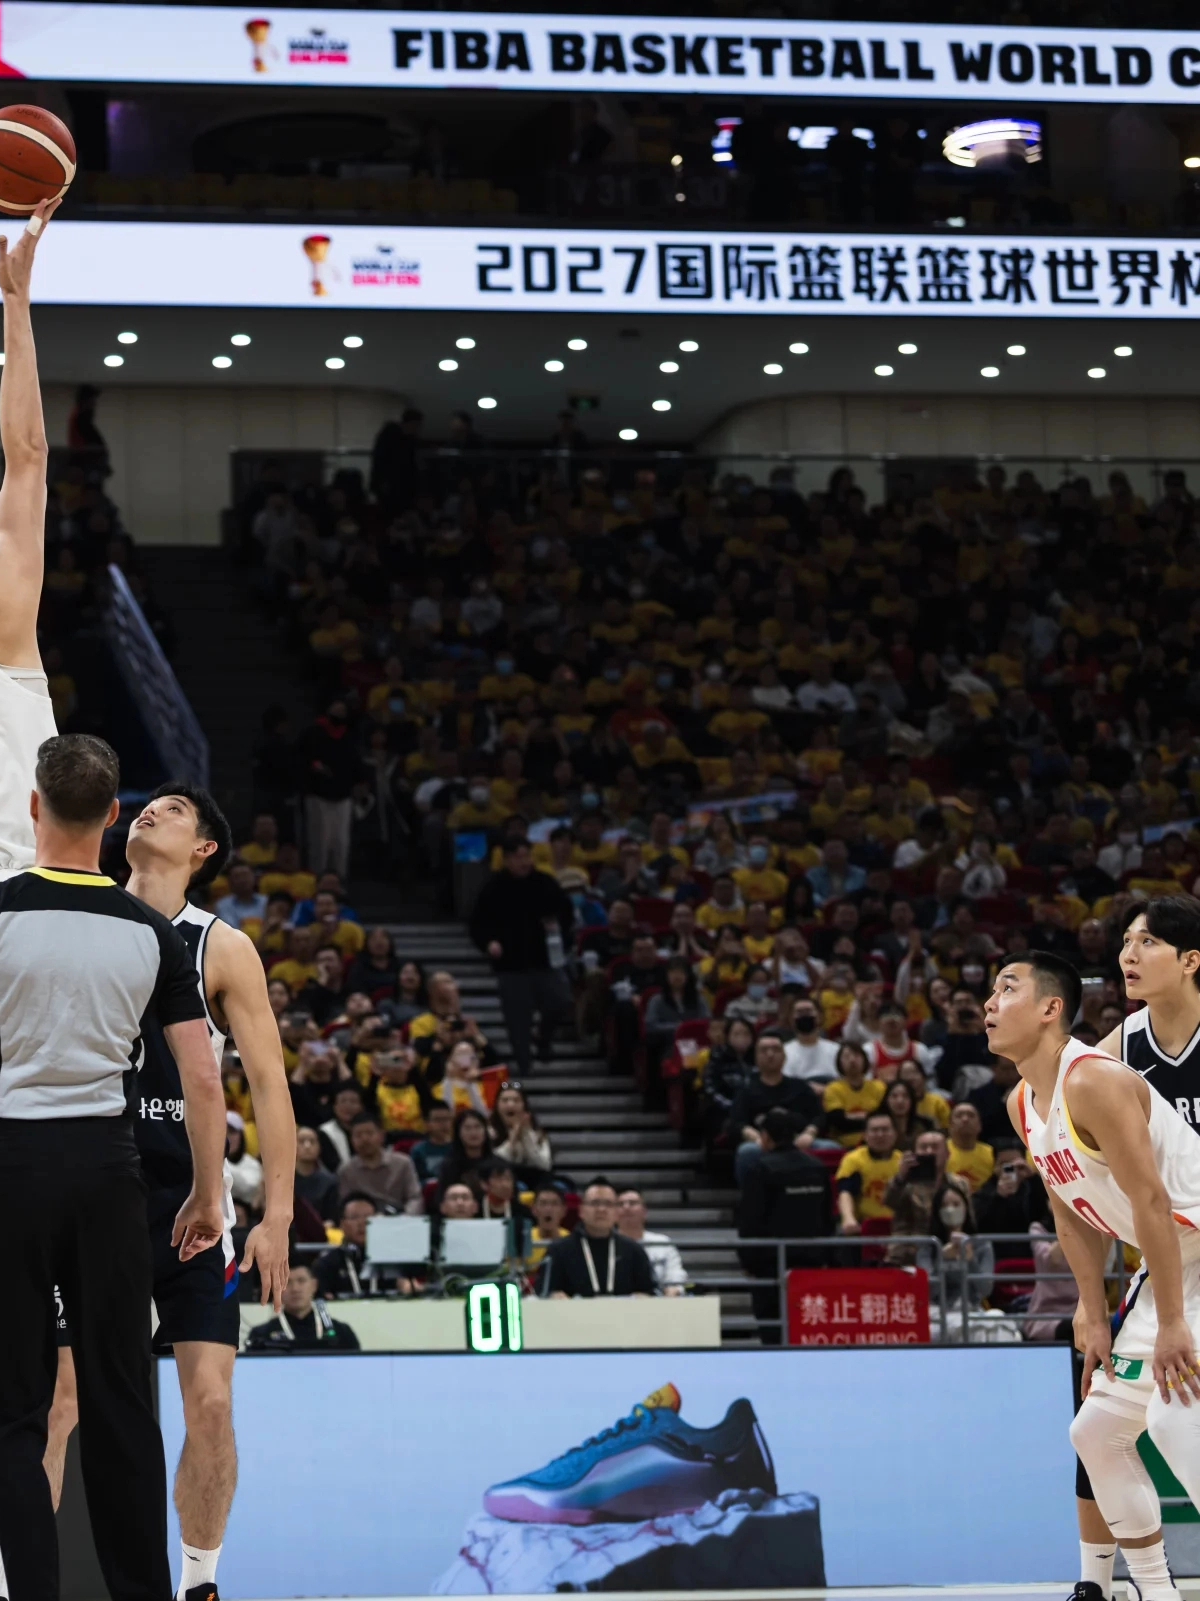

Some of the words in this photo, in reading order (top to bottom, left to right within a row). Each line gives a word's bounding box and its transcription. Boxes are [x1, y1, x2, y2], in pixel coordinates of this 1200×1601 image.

[391, 28, 533, 73] FIBA
[547, 31, 934, 81] BASKETBALL
[949, 42, 1153, 87] WORLD
[469, 1283, 522, 1352] 01
[800, 1293, 919, 1331] 禁止翻越
